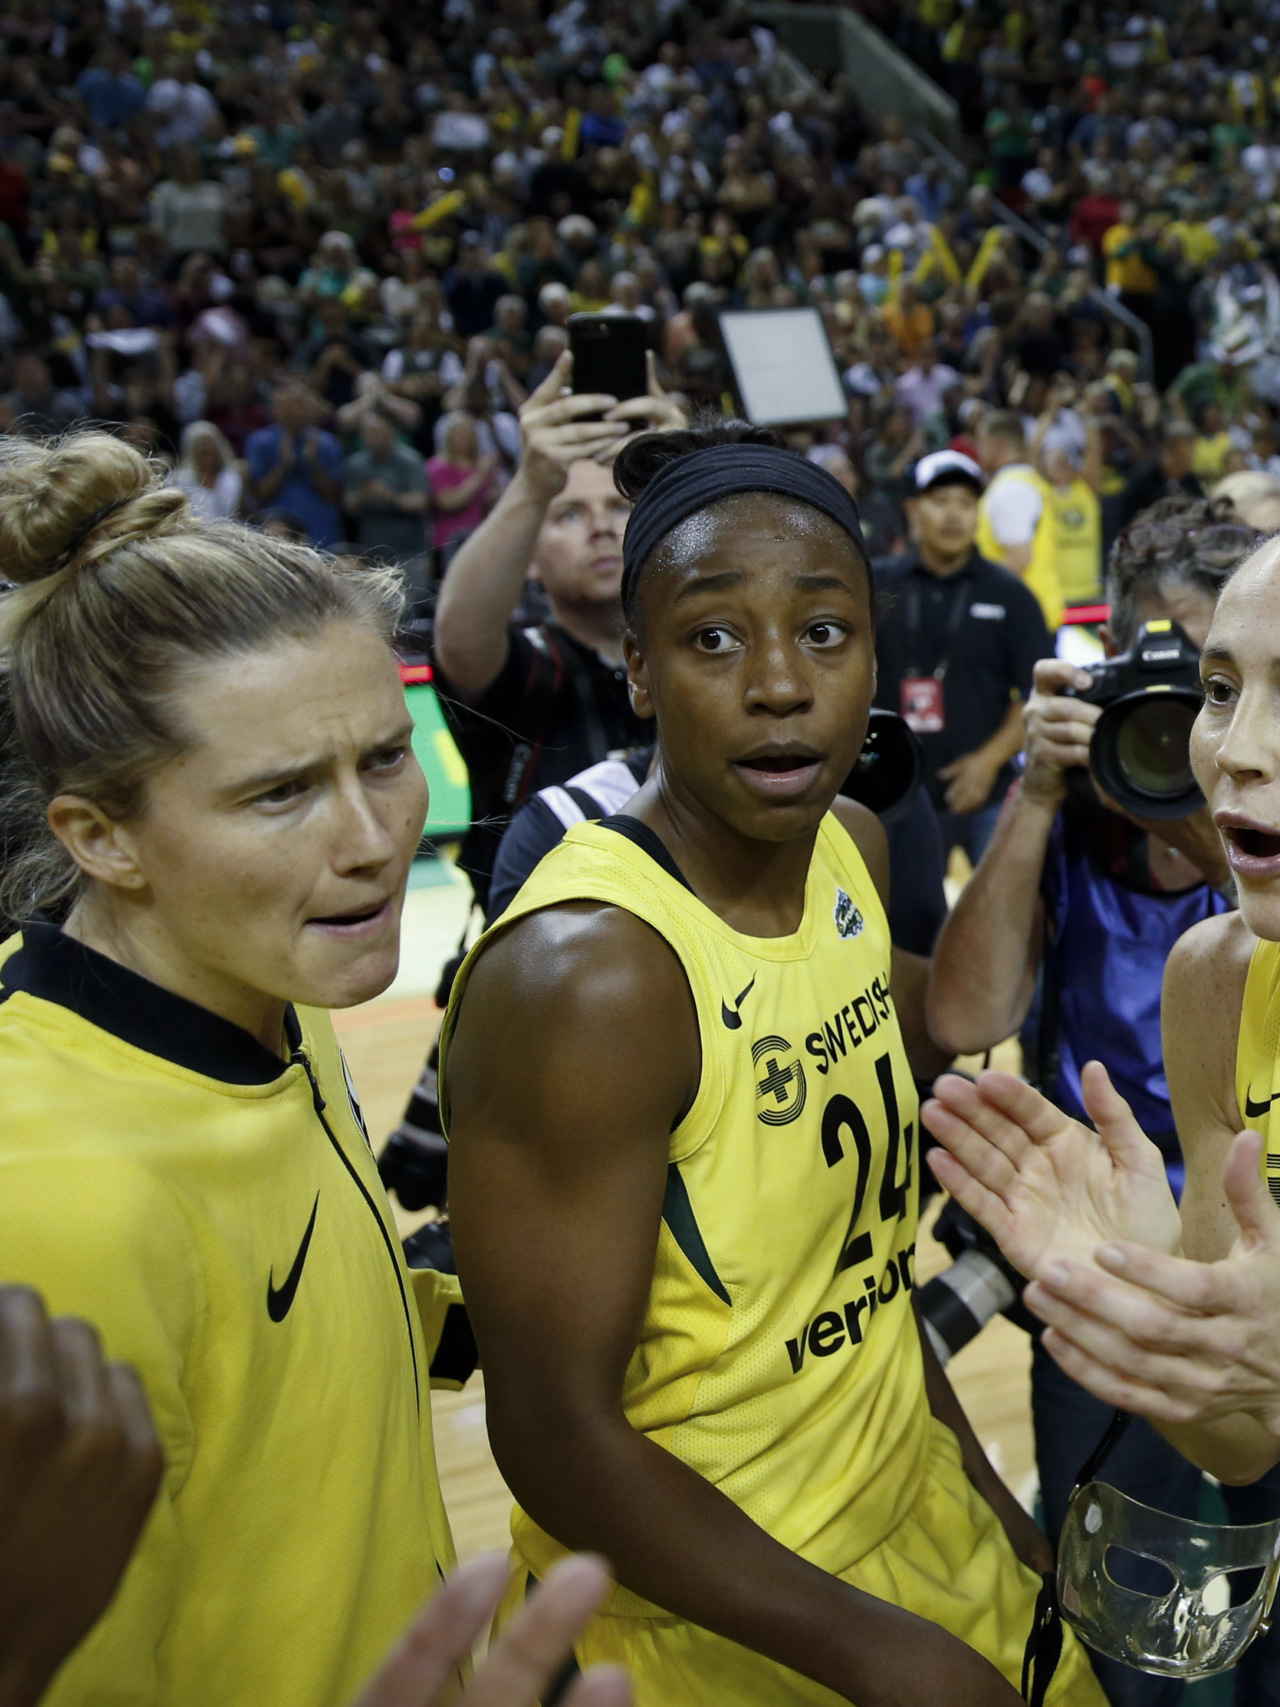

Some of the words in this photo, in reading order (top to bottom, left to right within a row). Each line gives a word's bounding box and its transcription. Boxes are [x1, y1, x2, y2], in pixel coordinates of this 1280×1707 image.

[1141, 648, 1180, 662] Canon
[804, 970, 891, 1076] SWEDISH
[820, 1051, 914, 1274] 24
[784, 1241, 916, 1376] verion
